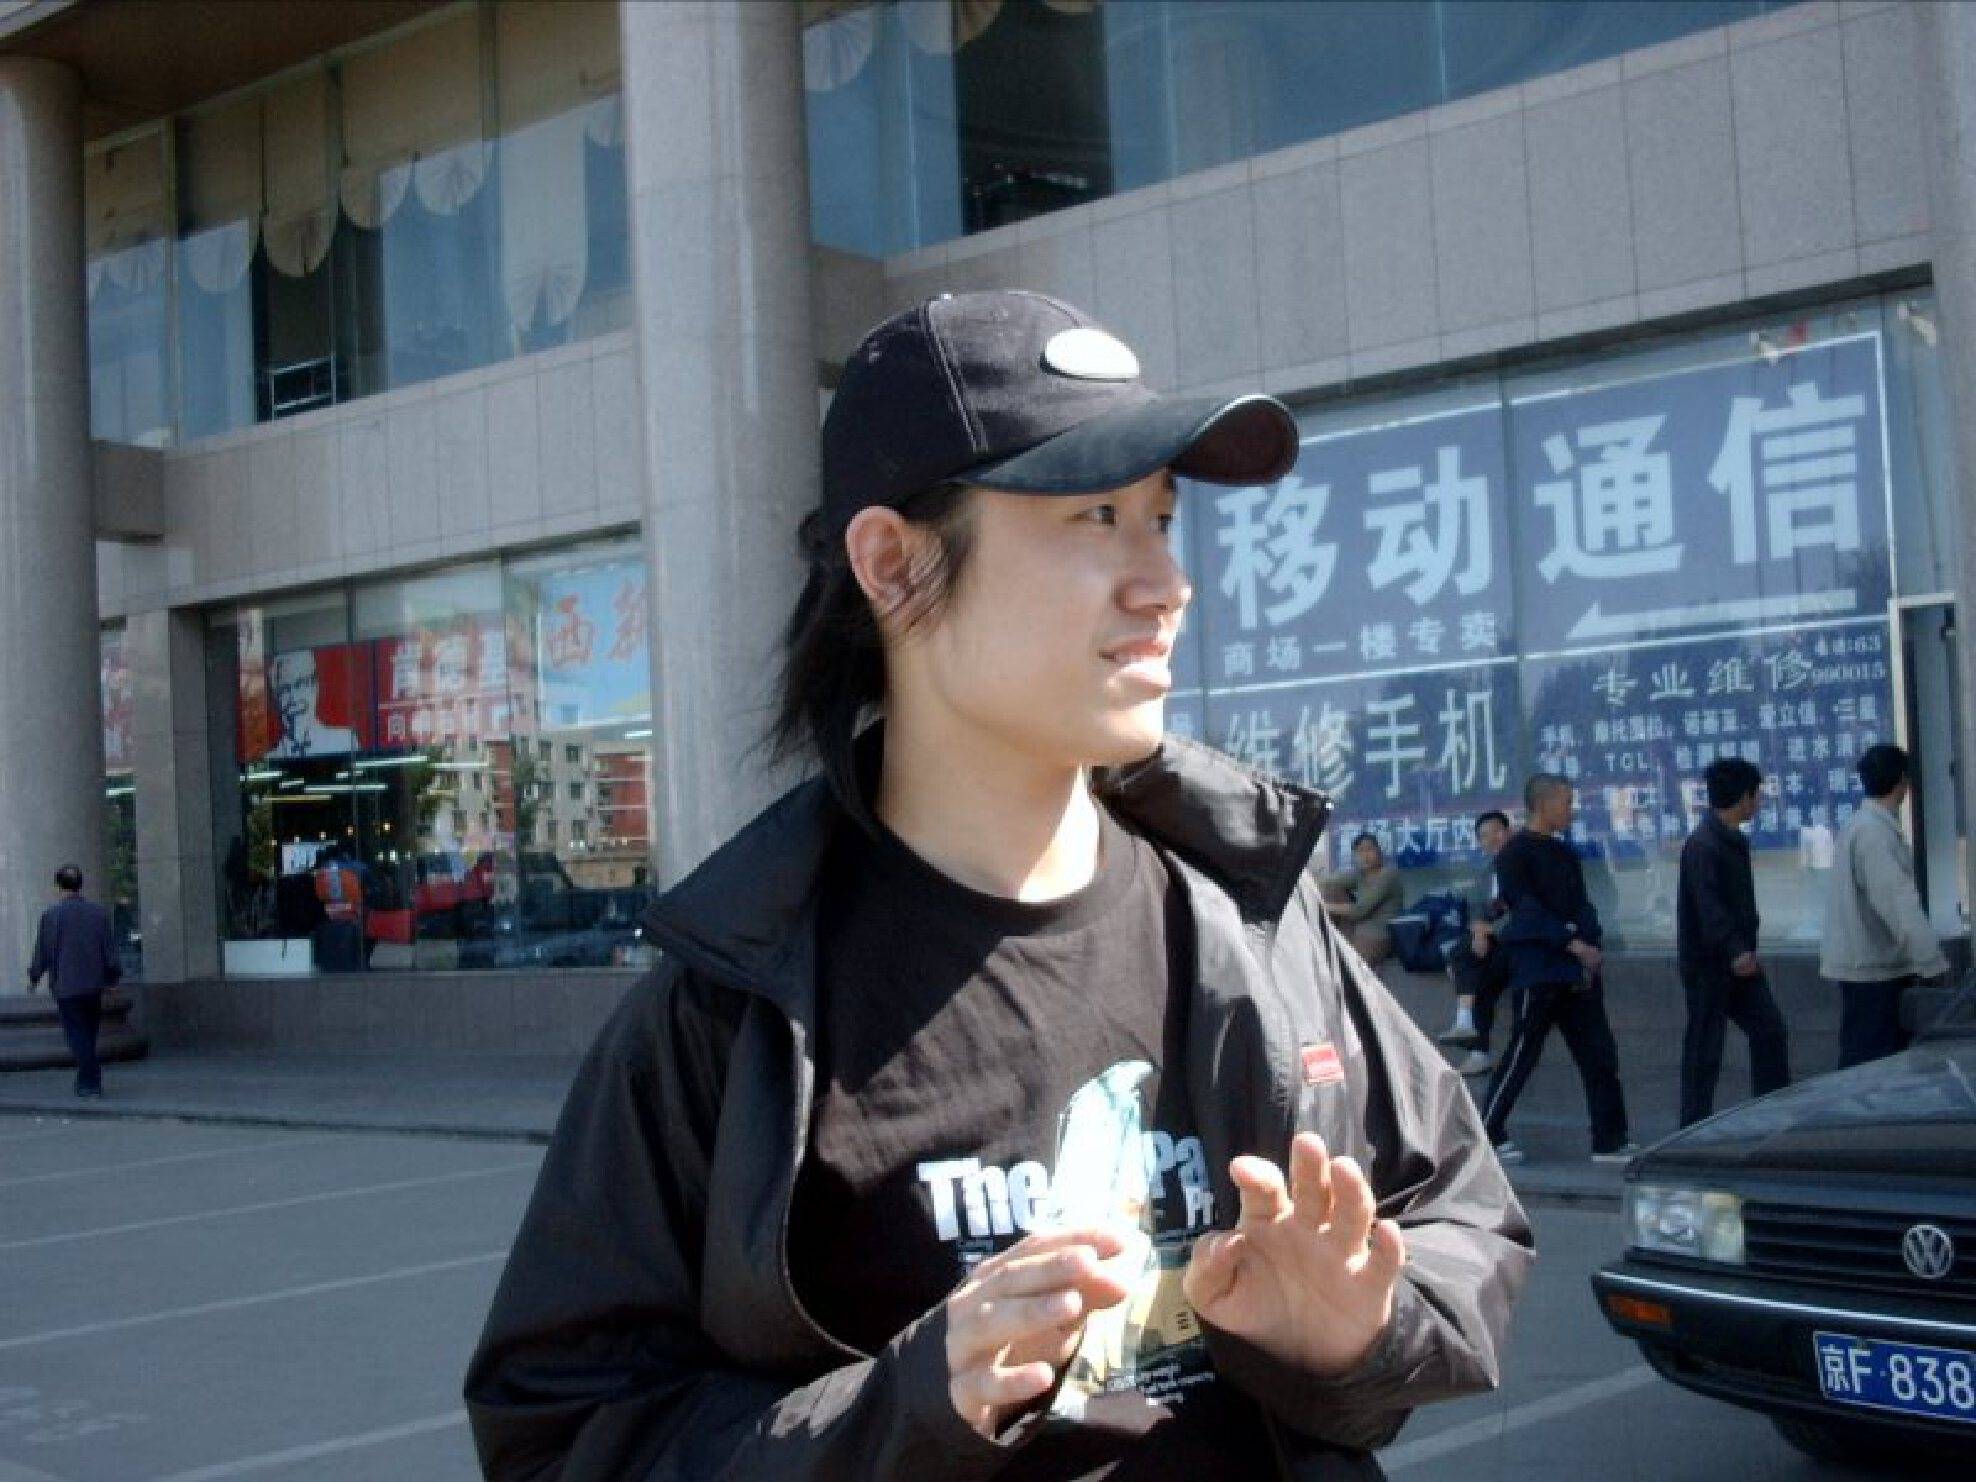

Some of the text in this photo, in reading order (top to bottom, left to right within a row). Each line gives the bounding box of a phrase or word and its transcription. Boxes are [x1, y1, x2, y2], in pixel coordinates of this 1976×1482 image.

[1214, 380, 1867, 632] 移动通信
[1223, 611, 1497, 677] 商场一楼专卖
[1592, 650, 1813, 706] 专业维修
[1225, 688, 1508, 799] 维修手机
[916, 1157, 1053, 1241] The
